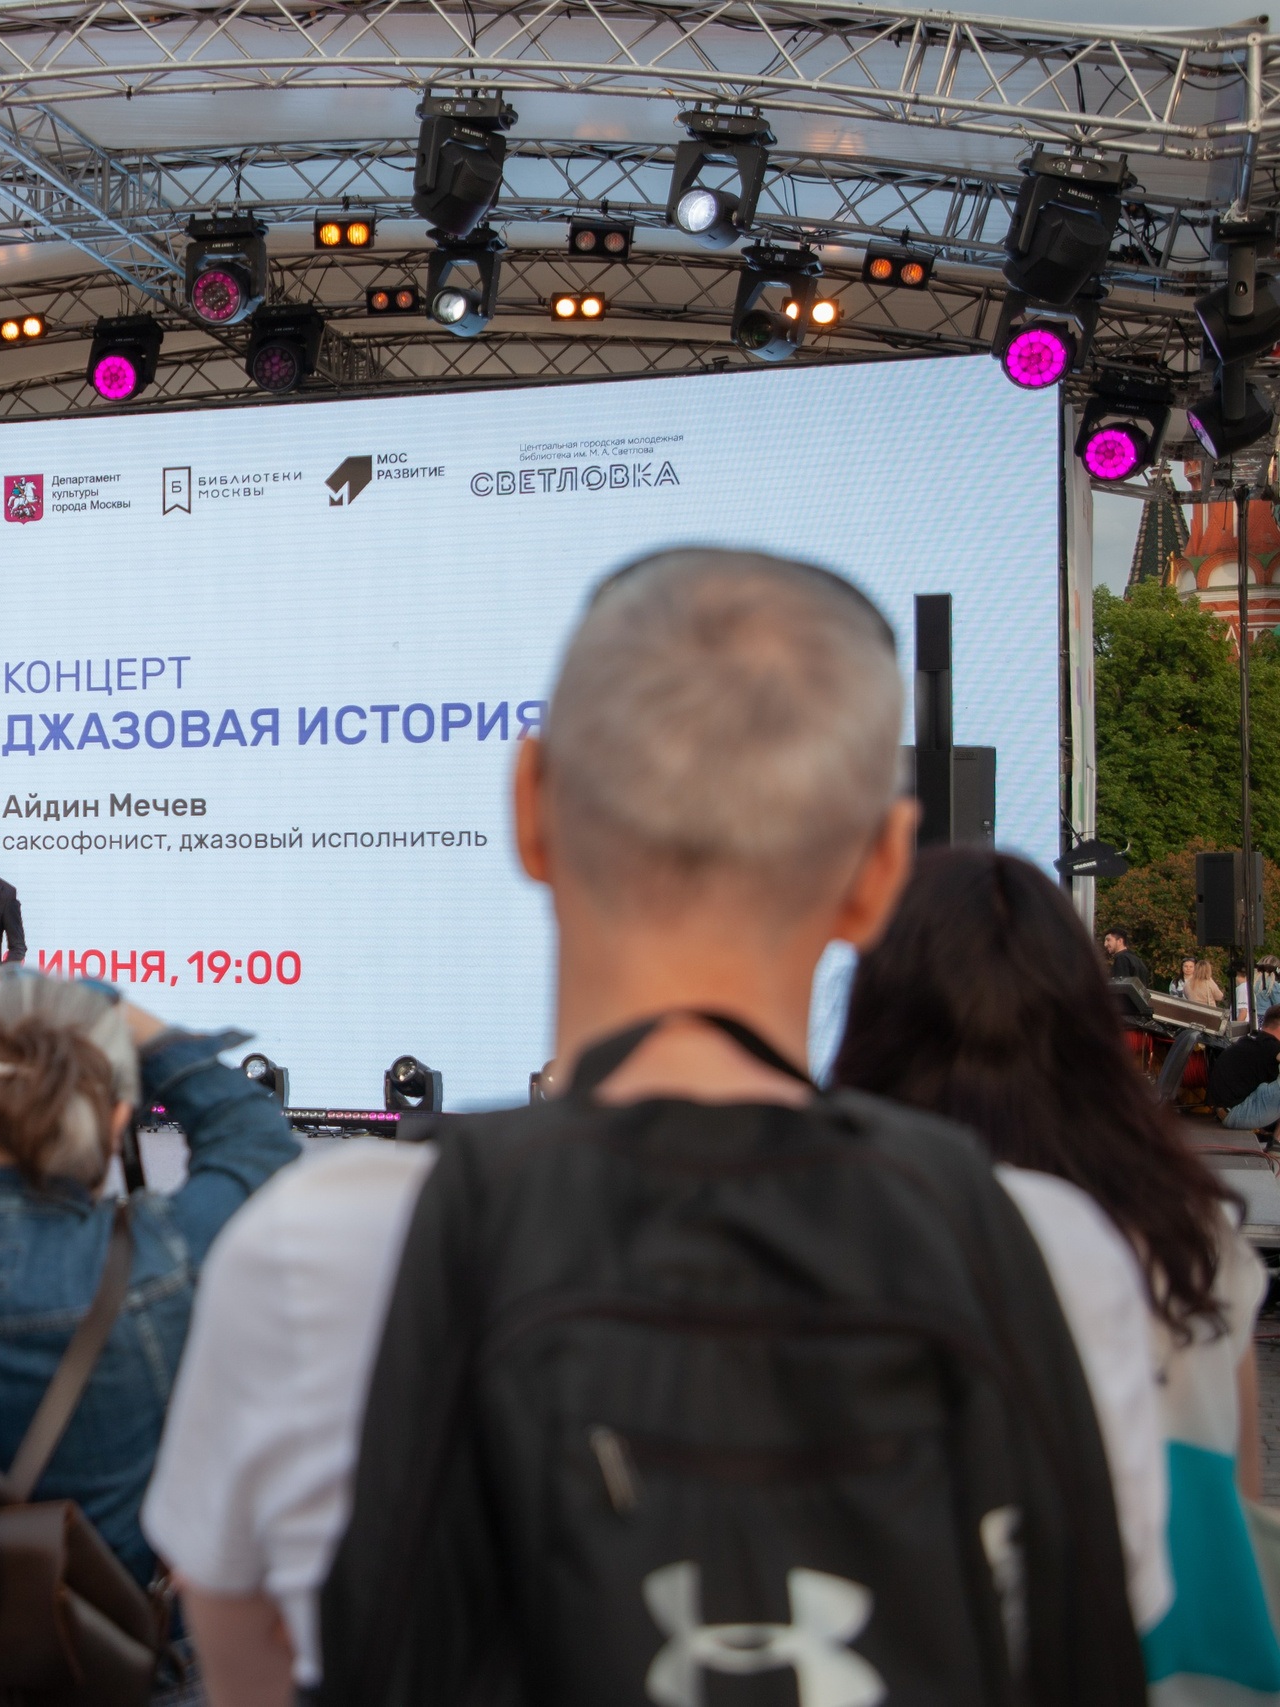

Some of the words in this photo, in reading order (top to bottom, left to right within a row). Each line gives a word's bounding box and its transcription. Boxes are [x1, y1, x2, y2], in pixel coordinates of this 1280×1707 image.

[520, 441, 578, 452] Центральная
[579, 437, 626, 449] городская
[627, 434, 684, 445] молодежная
[376, 453, 408, 465] МОС
[519, 452, 571, 462] библиотека
[573, 450, 587, 458] им.
[589, 449, 600, 457] М.
[601, 448, 610, 456] А.
[611, 446, 654, 456] Светлова
[51, 473, 121, 487] Департамент
[198, 471, 303, 486] БИБЛИОТЕКИ
[376, 466, 445, 480] РАЗВИТИЕ
[470, 461, 680, 497] СВЕТЛОВКА
[51, 488, 99, 499] культуры
[198, 487, 265, 499] МОСКВЫ
[51, 502, 87, 513] города
[90, 499, 131, 511] Москвы
[4, 656, 191, 696] КОНЦЕРТ
[1, 708, 280, 757] ДЖАЗОВАЯ
[298, 700, 548, 746] ИСТОРИЯ
[2, 793, 100, 821] Айдин
[109, 793, 207, 818] Мечев
[2, 830, 172, 855] саксофонист,
[179, 827, 303, 852] джазовый
[312, 830, 488, 850] исполнитель
[38, 948, 179, 987] ИЮНЯ,
[187, 949, 301, 985] 19:00
